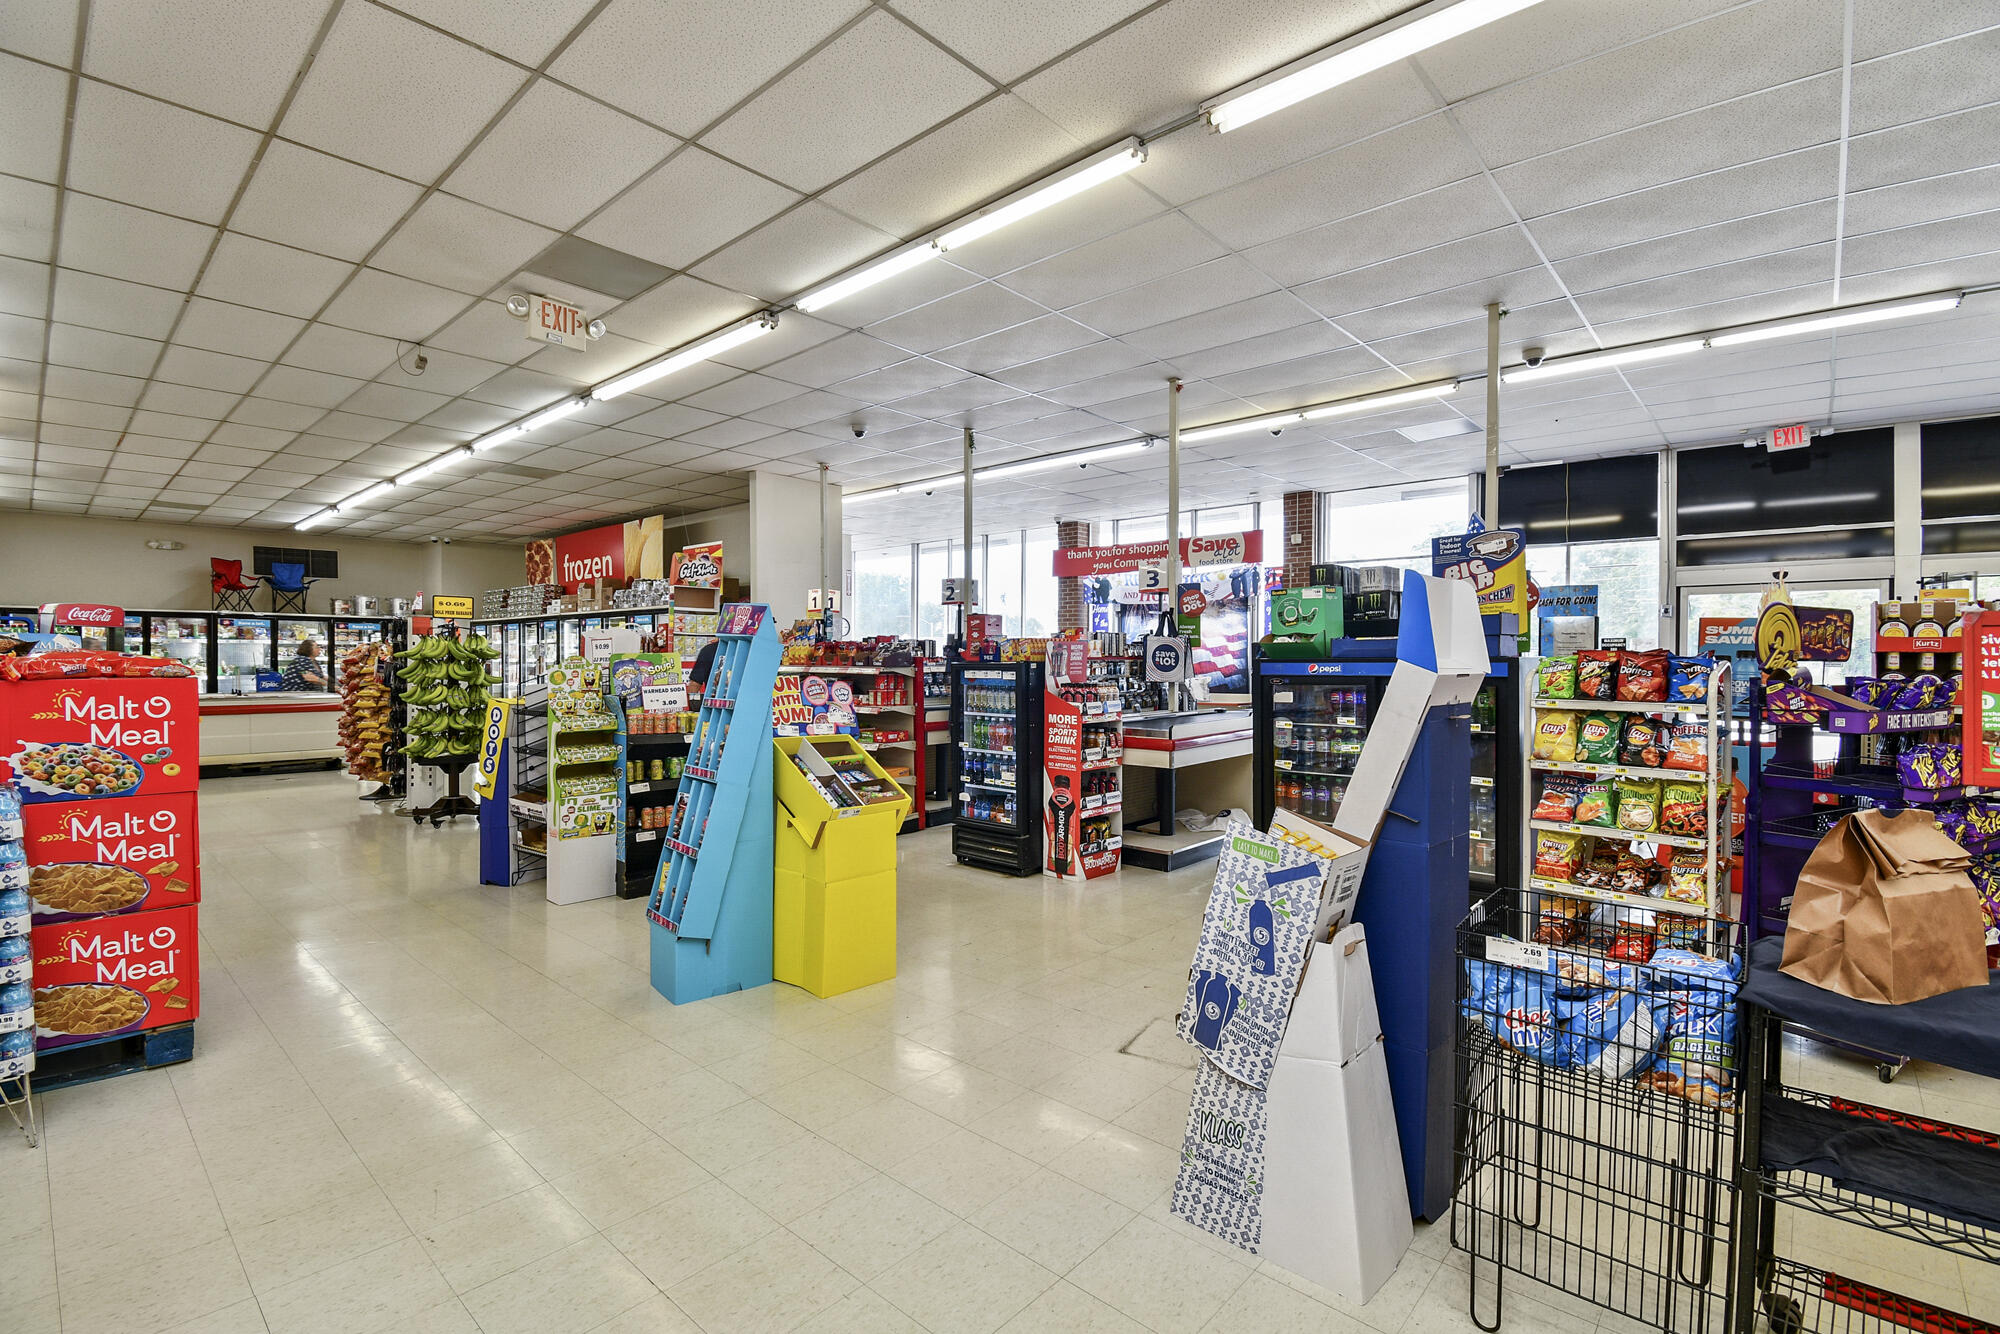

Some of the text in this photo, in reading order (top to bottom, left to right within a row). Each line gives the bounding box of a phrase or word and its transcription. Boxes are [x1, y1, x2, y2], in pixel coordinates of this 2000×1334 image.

[541, 301, 579, 336] EXIT
[1773, 425, 1805, 448] EXIT
[1067, 549, 1093, 559] thank
[1129, 542, 1169, 555] shoppin
[1192, 537, 1237, 553] Save
[563, 552, 613, 582] frozen
[1200, 558, 1214, 566] food
[1444, 559, 1488, 580] BIG
[1146, 570, 1159, 587] 3
[945, 586, 955, 601] 2
[1123, 591, 1138, 599] AND
[1183, 594, 1199, 602] Shop
[1488, 586, 1512, 600] CHEW
[812, 596, 817, 608] 1
[1183, 600, 1205, 613] Dot.
[1538, 596, 1598, 607] CASH FOR COINS
[68, 606, 114, 623] Coca-Cola
[1705, 625, 1757, 634] SUM
[1704, 635, 1756, 644] SAVI
[647, 658, 674, 675] SOUR!
[1319, 665, 1341, 674] pepsi
[1580, 660, 1610, 668] Doritos
[1620, 665, 1653, 677] Doritos
[260, 680, 280, 690] Ziploc
[773, 676, 799, 692] UN
[64, 696, 171, 722] Malt O
[1048, 714, 1077, 725] MORE
[1887, 713, 1935, 729] FACE THE INTENSI
[90, 720, 170, 750] Meal
[1048, 727, 1077, 737] SPORTS
[1672, 725, 1708, 736] RUFFLES
[483, 706, 502, 774] DOTS
[1048, 735, 1077, 745] DRINK
[71, 810, 176, 842] Malt O
[97, 834, 174, 863] Meal
[1237, 841, 1250, 853] EASY
[1251, 845, 1258, 855] TO
[1259, 847, 1274, 860] MAKE
[1671, 865, 1705, 875] BUFFALO
[1661, 923, 1695, 935] Ceetos
[71, 926, 176, 963] Malt O
[1218, 930, 1234, 943] EMPTY
[1238, 939, 1260, 957] PACKET
[1213, 948, 1231, 963] BOTTLE
[1216, 938, 1229, 951] INTO
[1256, 959, 1265, 970] OZ
[97, 950, 174, 982] Meal
[0, 1016, 13, 1024] .99
[1234, 1009, 1268, 1036] SHAKE UNTIL
[1505, 1006, 1552, 1030] Chex
[1228, 1028, 1248, 1043] ENJOY
[1232, 1019, 1274, 1049] DISSOLVED AND
[1673, 1041, 1712, 1053] BAGEL
[1200, 1110, 1244, 1149] KLASS
[1197, 1152, 1244, 1176] THE NEW WAY
[1204, 1166, 1236, 1185] TO DRINK
[1195, 1174, 1249, 1203] AGUAS FRESCAS
